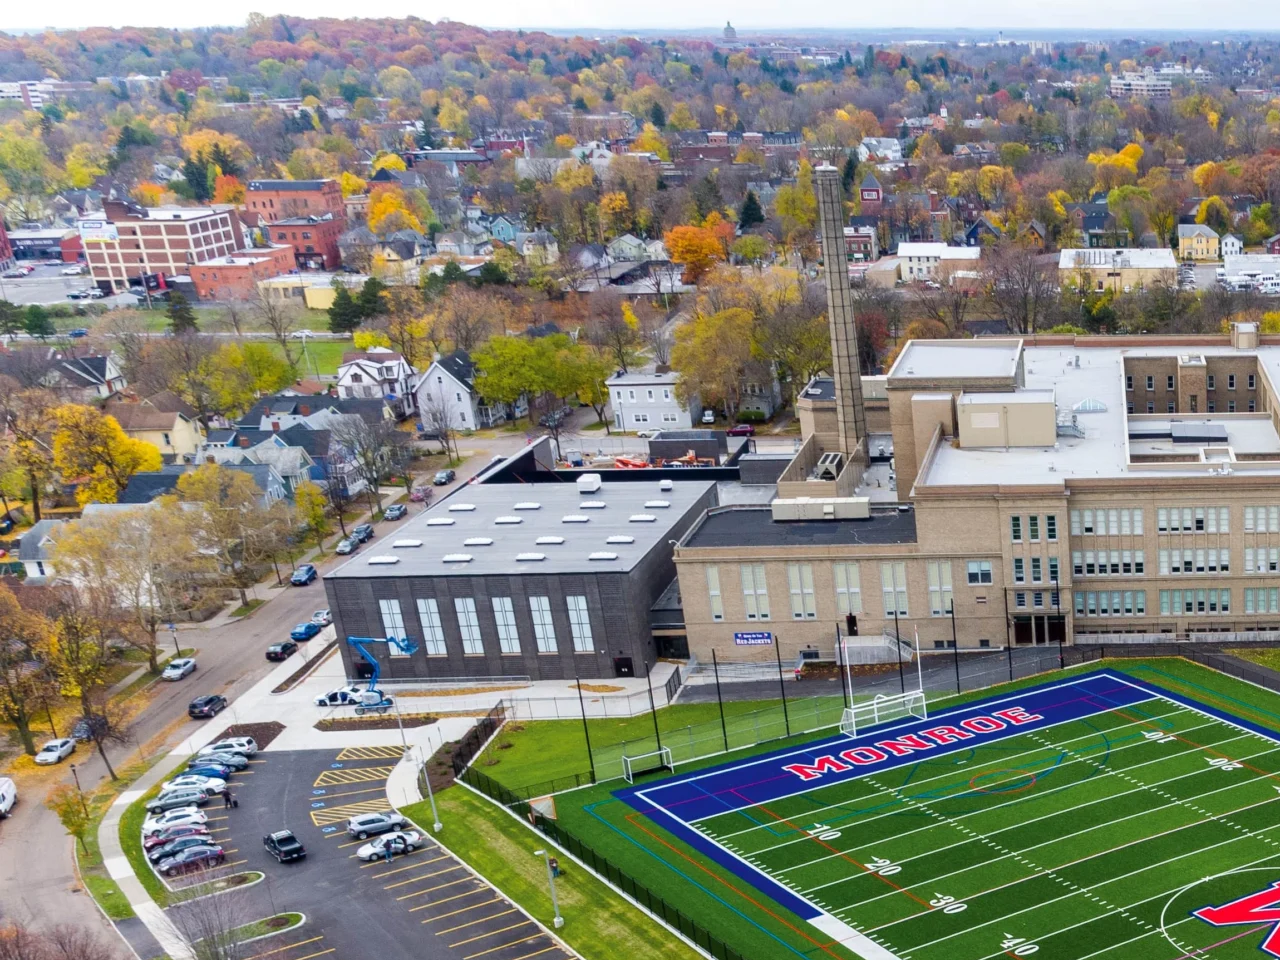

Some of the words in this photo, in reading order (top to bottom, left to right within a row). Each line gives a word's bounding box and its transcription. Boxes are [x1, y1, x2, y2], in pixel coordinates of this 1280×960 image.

[782, 707, 1044, 781] MONROE
[1144, 731, 1177, 744] 10
[1208, 757, 1243, 771] 20
[807, 824, 842, 841] 10
[864, 858, 902, 876] 20
[929, 895, 968, 914] 30
[1000, 936, 1040, 956] 40
